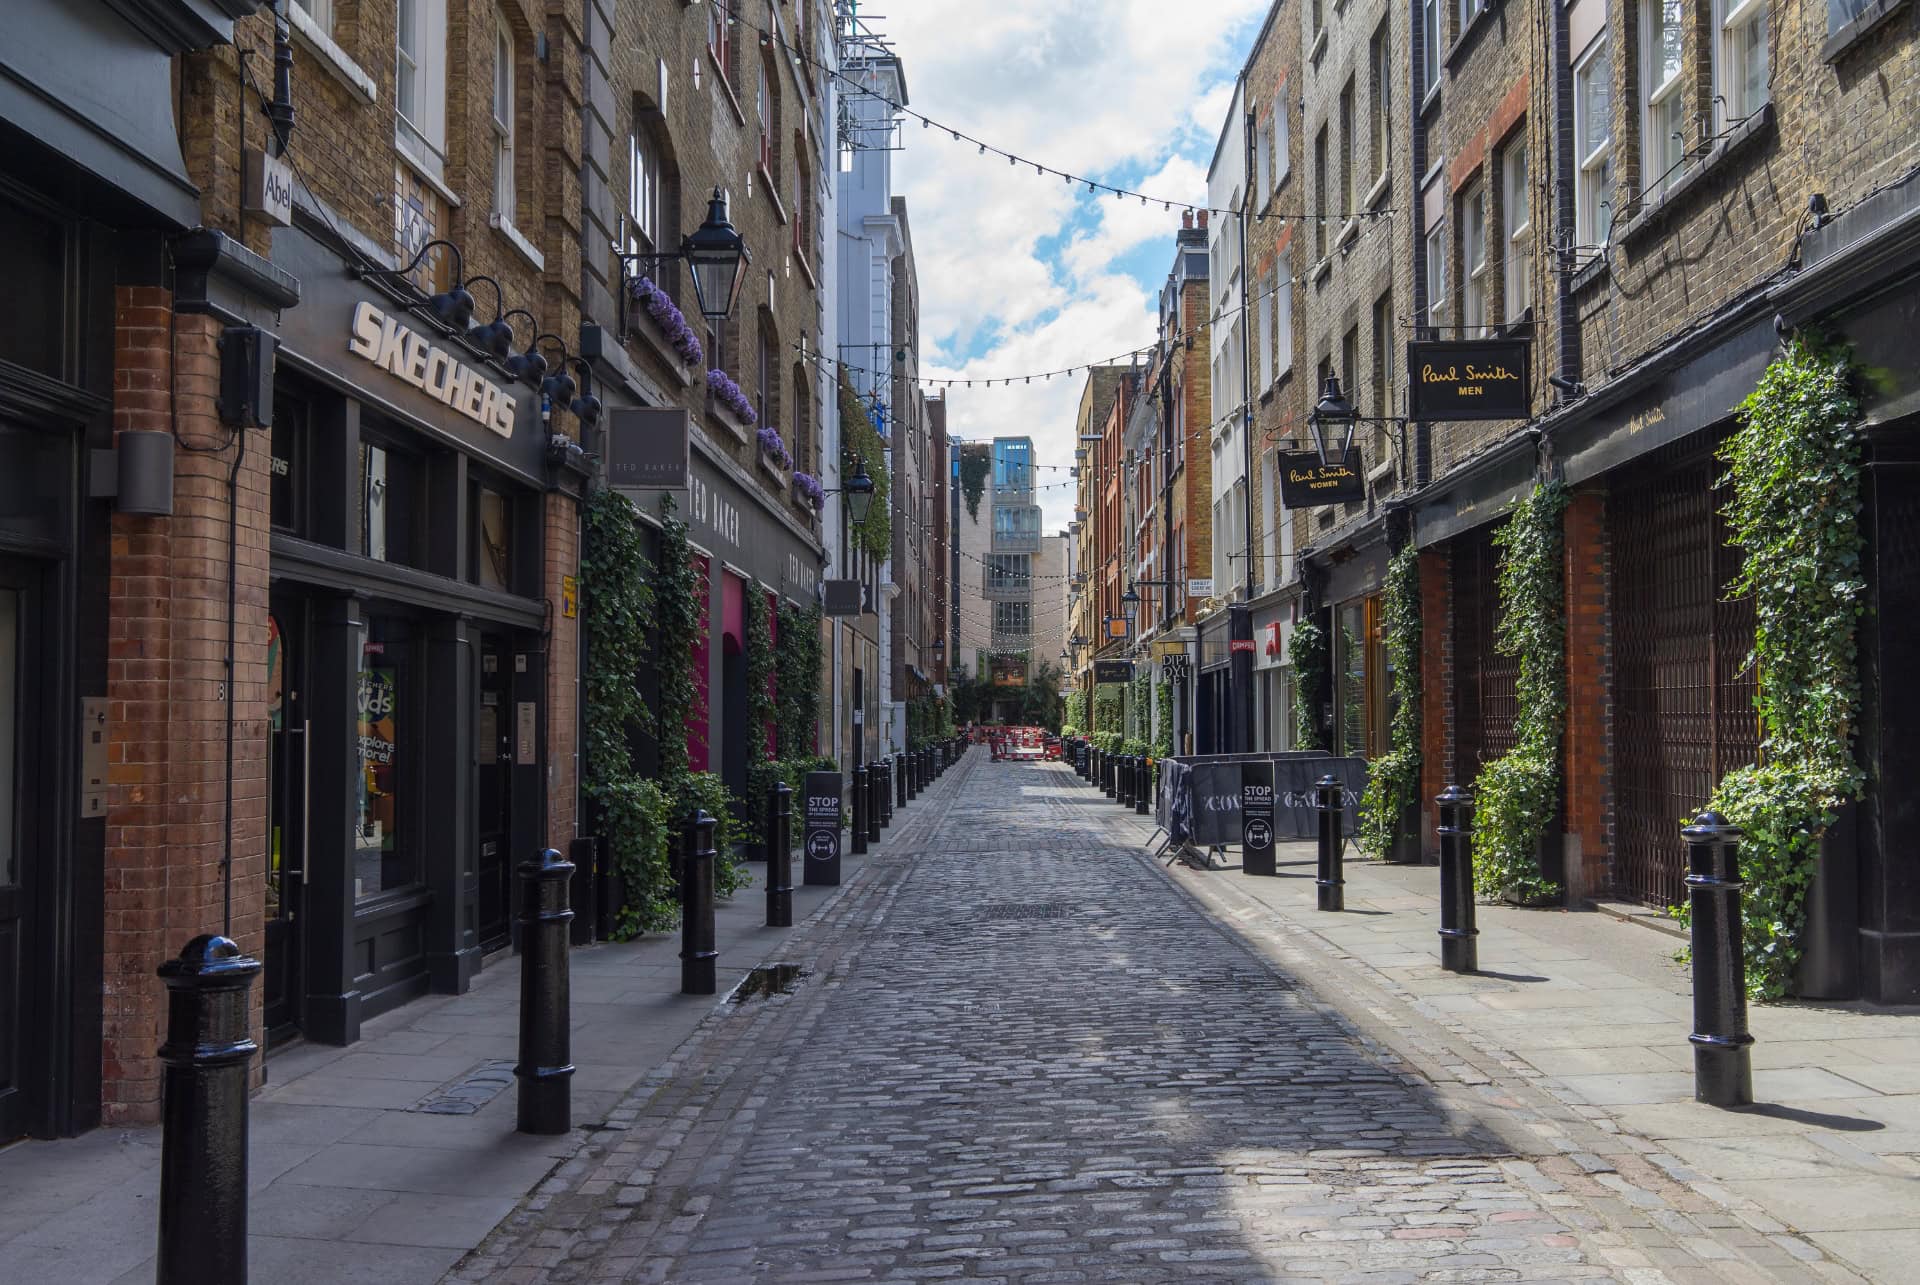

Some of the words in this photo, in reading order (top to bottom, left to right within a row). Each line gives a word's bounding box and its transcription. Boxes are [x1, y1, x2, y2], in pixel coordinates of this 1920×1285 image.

[265, 171, 290, 210] Abel
[349, 301, 517, 439] SKECHERS
[1422, 364, 1460, 383] Paul
[1466, 364, 1519, 380] Smith
[1458, 386, 1483, 395] MEN
[616, 463, 636, 472] TED
[1290, 469, 1316, 483] Paul
[1318, 467, 1355, 479] Smith
[1309, 480, 1338, 489] WOMEN
[689, 474, 707, 524] TED
[713, 491, 740, 549] BAKER
[789, 552, 799, 585] TED
[800, 561, 815, 598] BAKER
[1162, 655, 1190, 666] DIPT
[1244, 786, 1272, 796] STOP
[808, 797, 839, 807] STOP
